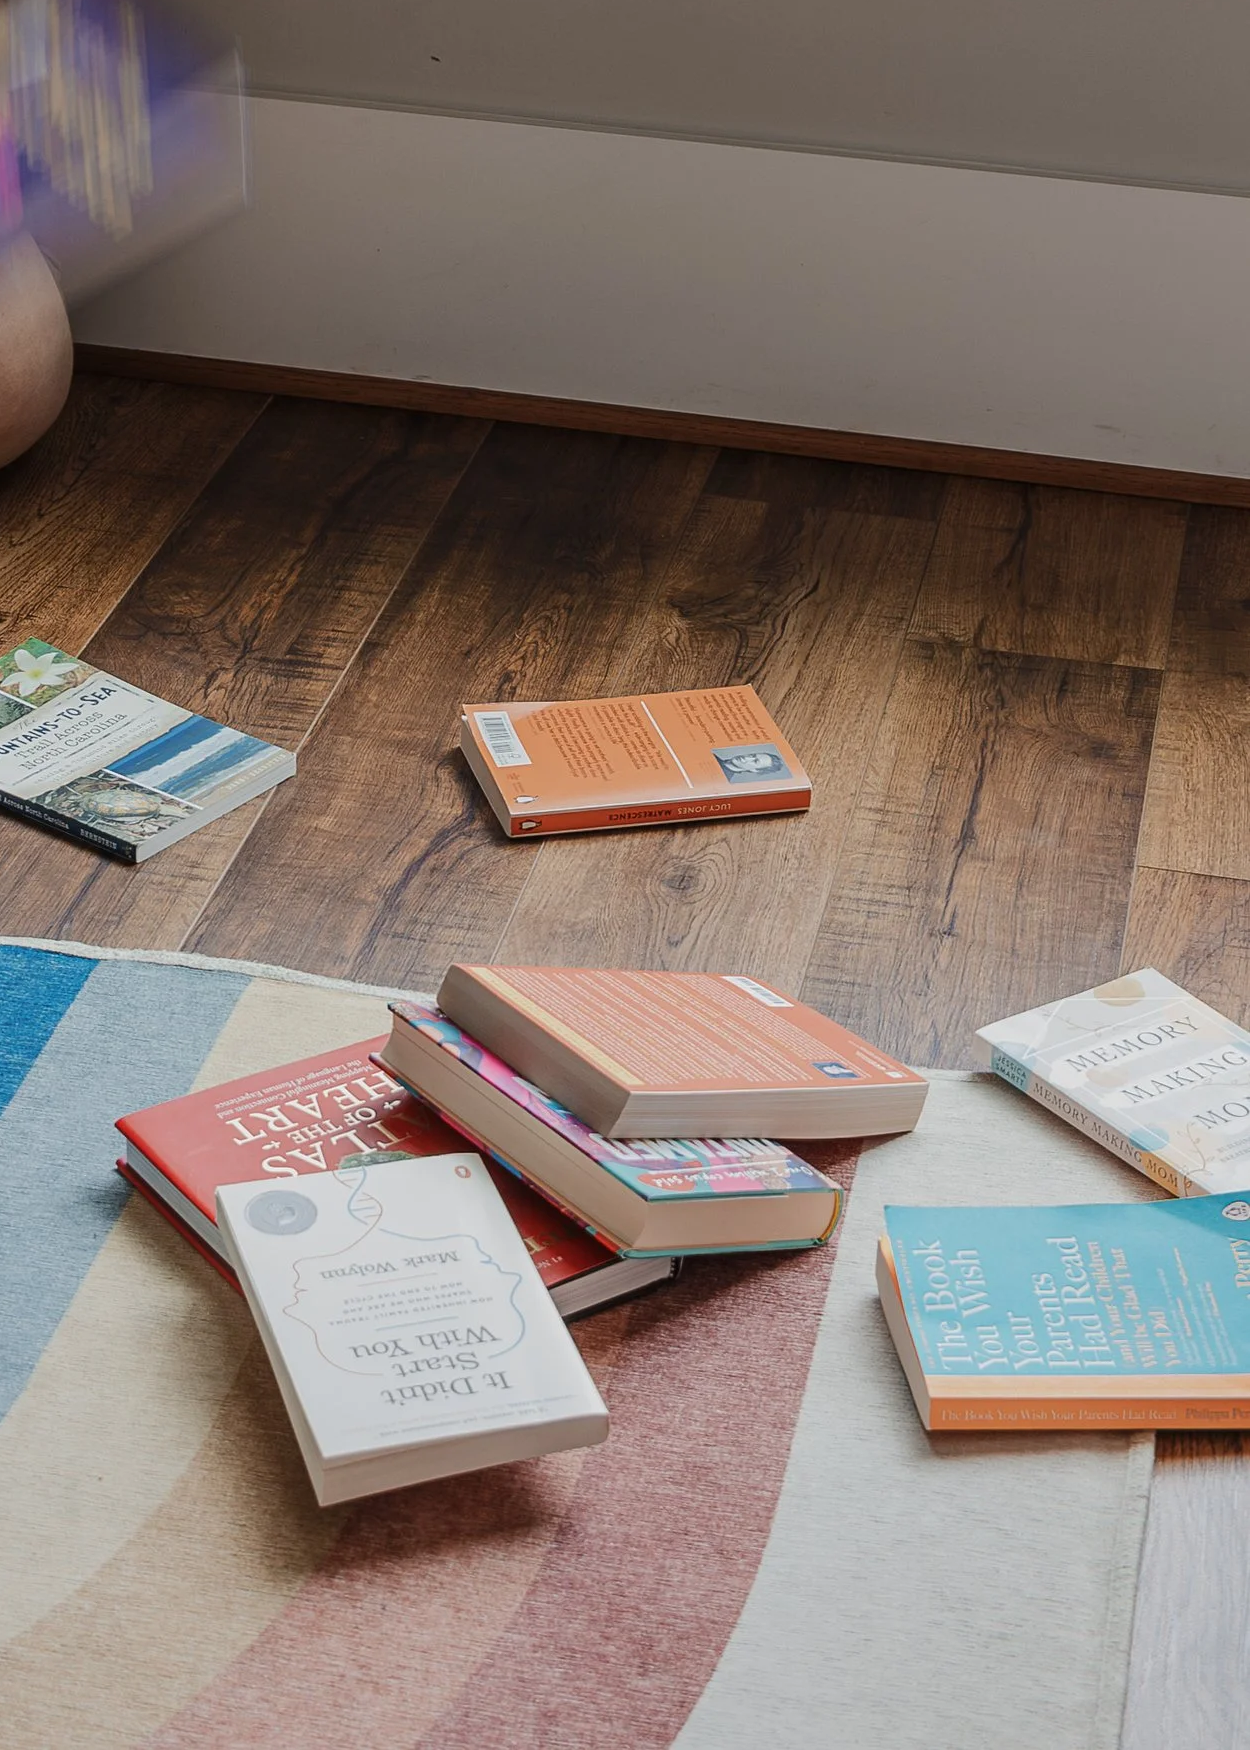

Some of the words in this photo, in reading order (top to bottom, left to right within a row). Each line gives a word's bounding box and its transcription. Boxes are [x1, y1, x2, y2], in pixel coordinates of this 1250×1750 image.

[13, 738, 55, 759] Trail
[49, 710, 105, 740] Across
[19, 745, 68, 770] North
[61, 711, 128, 748] Carolina
[3, 796, 24, 810] Across
[24, 804, 43, 818] North
[43, 812, 70, 830] Carolina
[609, 809, 672, 821] MATRESCENCE
[677, 806, 707, 815] JONES
[709, 803, 731, 812] LUCY
[80, 828, 117, 850] BERNSTEIN
[1066, 1016, 1199, 1073] MEMORY
[306, 1064, 345, 1082] Language
[334, 1064, 373, 1081] Mapping
[346, 1059, 361, 1069] the
[996, 1055, 1028, 1080] JESSICA
[295, 1076, 305, 1086] of
[995, 1063, 1025, 1088] SMARTT
[1122, 1051, 1249, 1104] MAKING
[262, 1080, 295, 1095] Human
[286, 1075, 334, 1098] Meaningful
[214, 1090, 262, 1109] Experience
[225, 1070, 404, 1146] HEART
[236, 1093, 286, 1112] Connection
[216, 1108, 234, 1119] and
[344, 1106, 377, 1127] OF
[1195, 1096, 1250, 1130] MO
[287, 1118, 342, 1145] THE
[1033, 1082, 1089, 1125] MEMORY
[1090, 1121, 1142, 1164] MAKING
[1146, 1159, 1179, 1188] MOM
[652, 1174, 683, 1188] sold
[684, 1171, 724, 1184] copies
[402, 1250, 460, 1268] Mark
[1111, 1247, 1130, 1278] That
[1229, 1237, 1250, 1288] Perry
[320, 1260, 398, 1280] Wolynn
[912, 1240, 957, 1312] Book
[1047, 1236, 1093, 1304] Read
[1086, 1241, 1114, 1301] Children
[398, 1287, 421, 1295] END
[439, 1281, 463, 1289] HOW
[950, 1249, 992, 1317] Wish
[341, 1294, 374, 1305] CYCLE
[376, 1291, 396, 1299] THE
[406, 1295, 431, 1304] WHO
[468, 1296, 493, 1304] HOW
[1119, 1285, 1141, 1319] Glad
[341, 1306, 363, 1314] AND
[366, 1302, 386, 1310] ARE
[372, 1308, 409, 1319] FAMILY
[411, 1299, 466, 1313] INHERITED
[328, 1315, 369, 1326] TRAUMA
[1031, 1272, 1081, 1367] Parents
[1104, 1304, 1126, 1335] Your
[1132, 1322, 1148, 1337] be
[348, 1338, 413, 1358] You
[415, 1326, 501, 1350] With
[936, 1320, 972, 1369] The
[975, 1325, 1009, 1369] You
[1007, 1312, 1043, 1369] Your
[1070, 1313, 1115, 1368] Had
[1135, 1341, 1158, 1367] Will
[1162, 1341, 1181, 1366] You
[392, 1352, 480, 1377] Start
[380, 1377, 479, 1405] Didn't
[482, 1371, 512, 1390] It
[942, 1410, 961, 1421] The
[965, 1409, 995, 1421] Book
[997, 1409, 1018, 1421] You
[1020, 1409, 1048, 1421] Wish
[1051, 1409, 1075, 1420] Your
[1078, 1409, 1119, 1420] Parents
[1122, 1409, 1145, 1420] Had
[1149, 1409, 1177, 1419] Read
